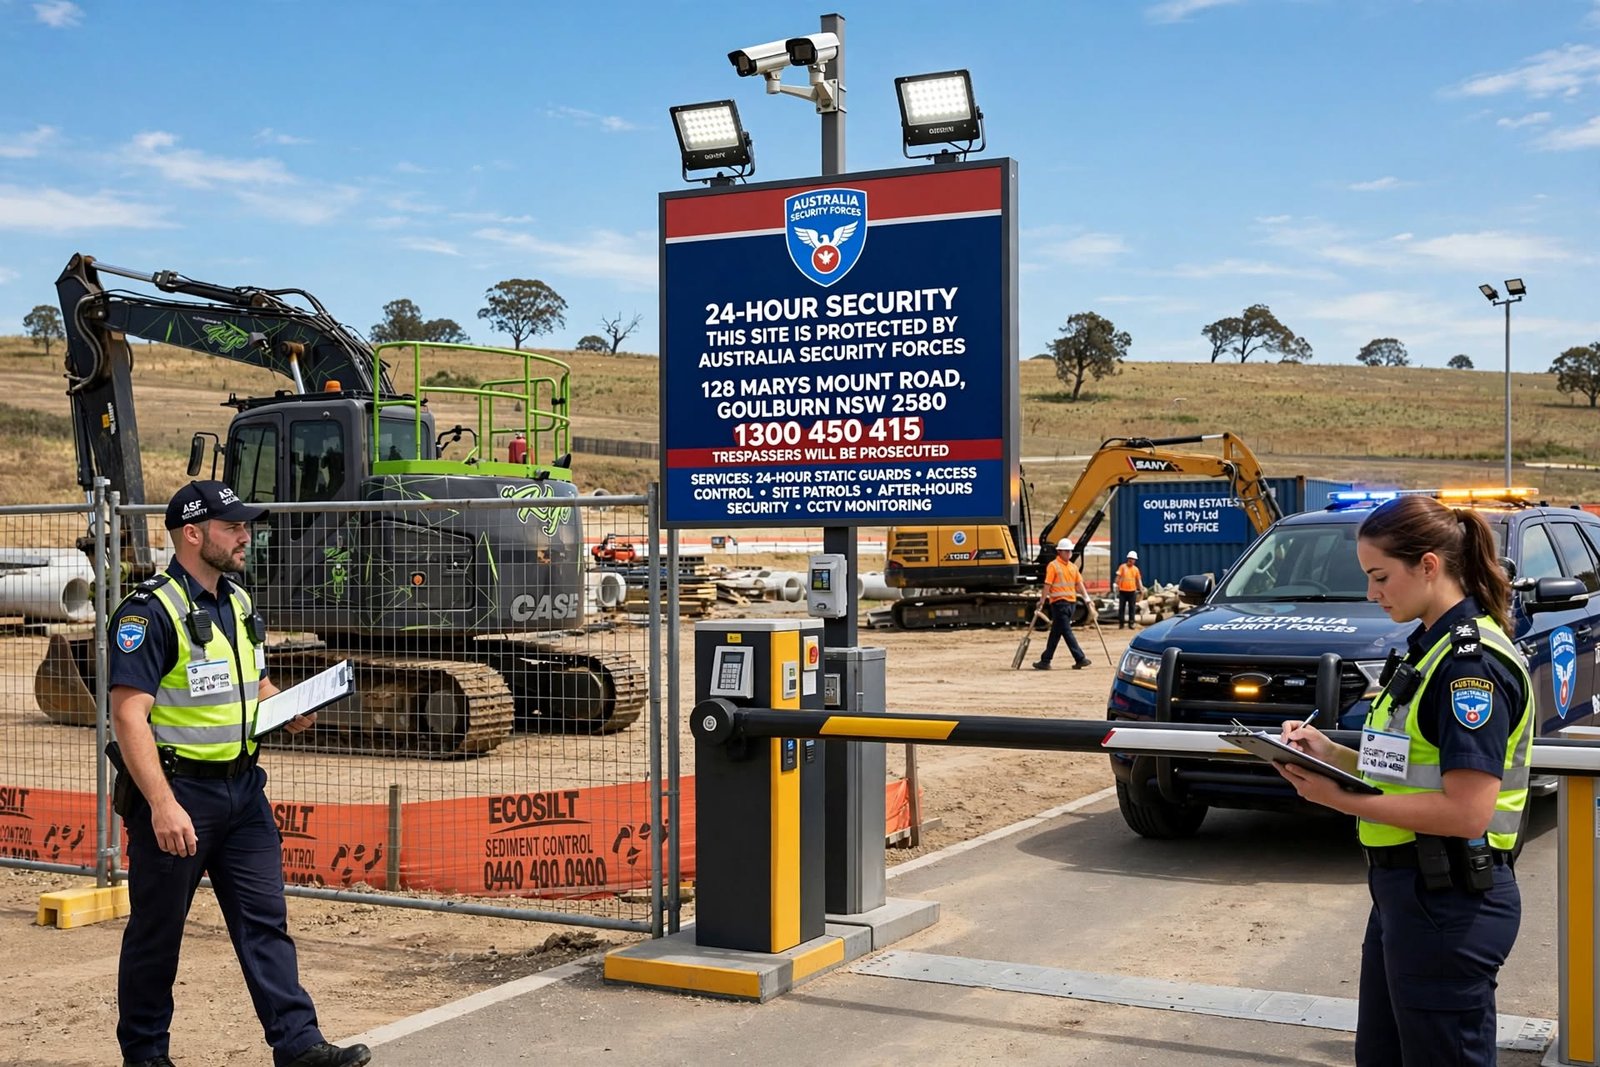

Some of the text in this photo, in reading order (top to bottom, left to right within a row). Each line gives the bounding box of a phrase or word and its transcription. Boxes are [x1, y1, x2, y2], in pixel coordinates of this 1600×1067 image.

[793, 194, 859, 212] AUSTRALIA
[790, 206, 862, 222] SECURITY FORCES
[706, 287, 958, 324] 24-HOUR SECURITY
[706, 316, 958, 346] THIS SITE IS PROTECTED BY
[699, 338, 965, 368] AUSTRALIA SECURITY FORCES
[702, 370, 965, 397] 128 MARYS MOUNT ROAD,
[718, 392, 946, 418] GOULBURN NSW 2580
[735, 417, 920, 446] 1300 450 415
[712, 445, 949, 462] TRESPASSERS WILL BE PROSECUTED
[1136, 461, 1168, 470] SANY
[691, 467, 976, 485] SERVICES: 24-HOUR STATIC GUARDS ACCESS
[694, 482, 972, 500] CONTROL SITE PATROLS AFTER-HOURS
[183, 500, 201, 513] ASF
[728, 499, 931, 514] SECURITY CCTV MONITORING
[1143, 498, 1239, 510] GOULBURN ESTATES
[1163, 510, 1219, 521] No 1 Pty Ltd
[1164, 523, 1219, 533] SITE OFFICE
[510, 593, 579, 622] CASE
[1227, 616, 1348, 625] AUSTRALIA
[1287, 624, 1357, 633] FORCES
[1457, 643, 1477, 654] ASF
[489, 791, 579, 824] ECOSILT
[486, 834, 593, 857] SEDIMENT CONTROL
[484, 860, 523, 891] 0440
